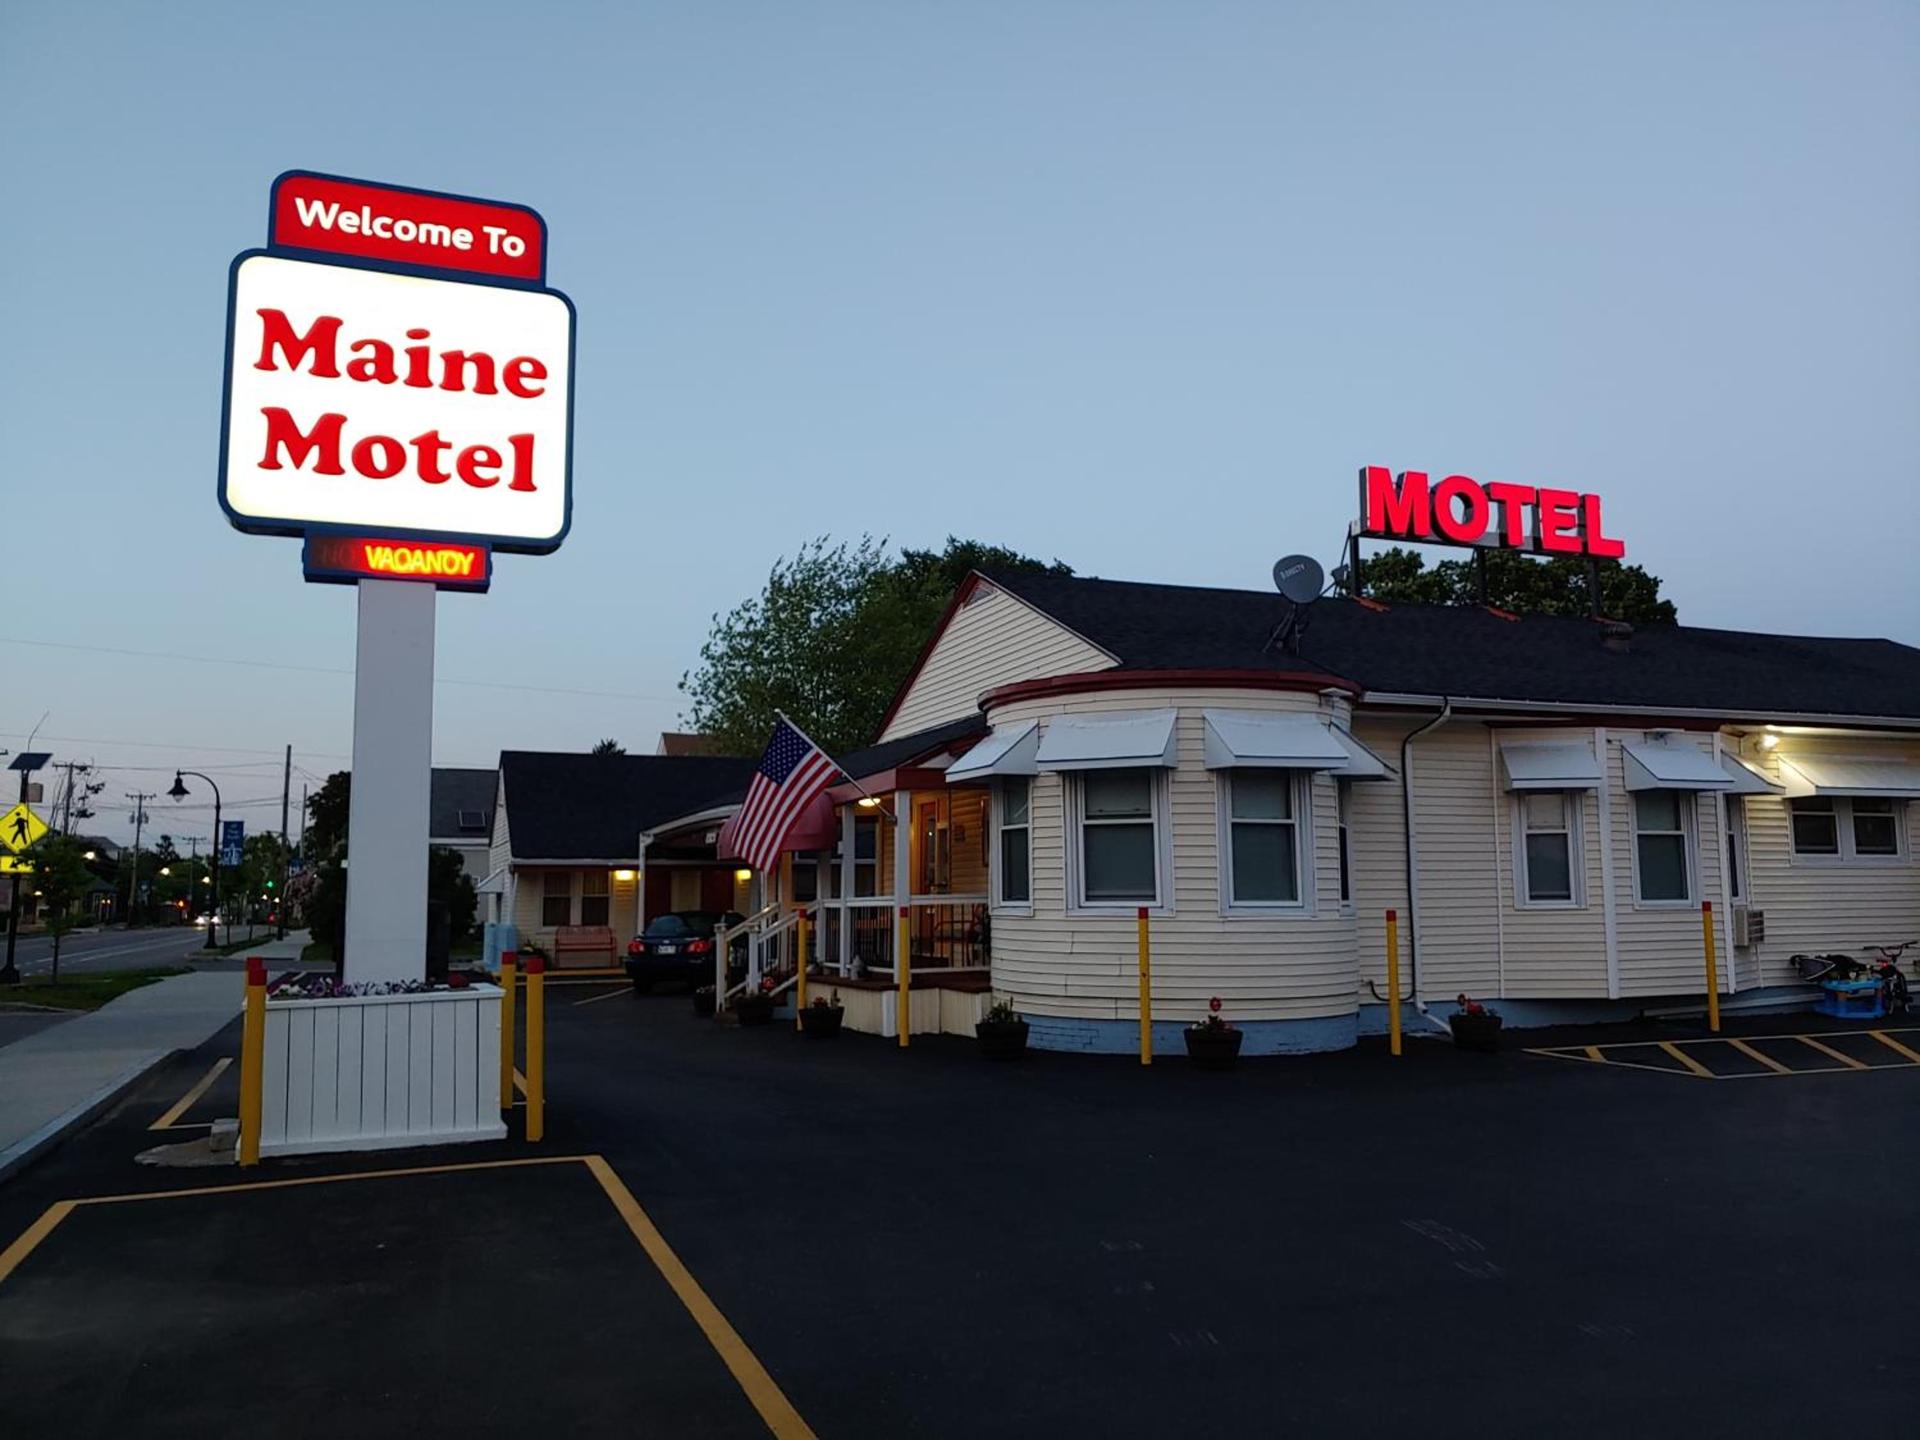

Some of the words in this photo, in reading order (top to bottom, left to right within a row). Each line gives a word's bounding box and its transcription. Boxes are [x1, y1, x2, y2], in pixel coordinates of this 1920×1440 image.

[294, 197, 474, 250] Welcome
[482, 226, 526, 257] To
[254, 308, 548, 398] Maine
[257, 407, 537, 492] Motel
[1363, 466, 1625, 559] MOTEL
[364, 545, 475, 576] VACANCY
